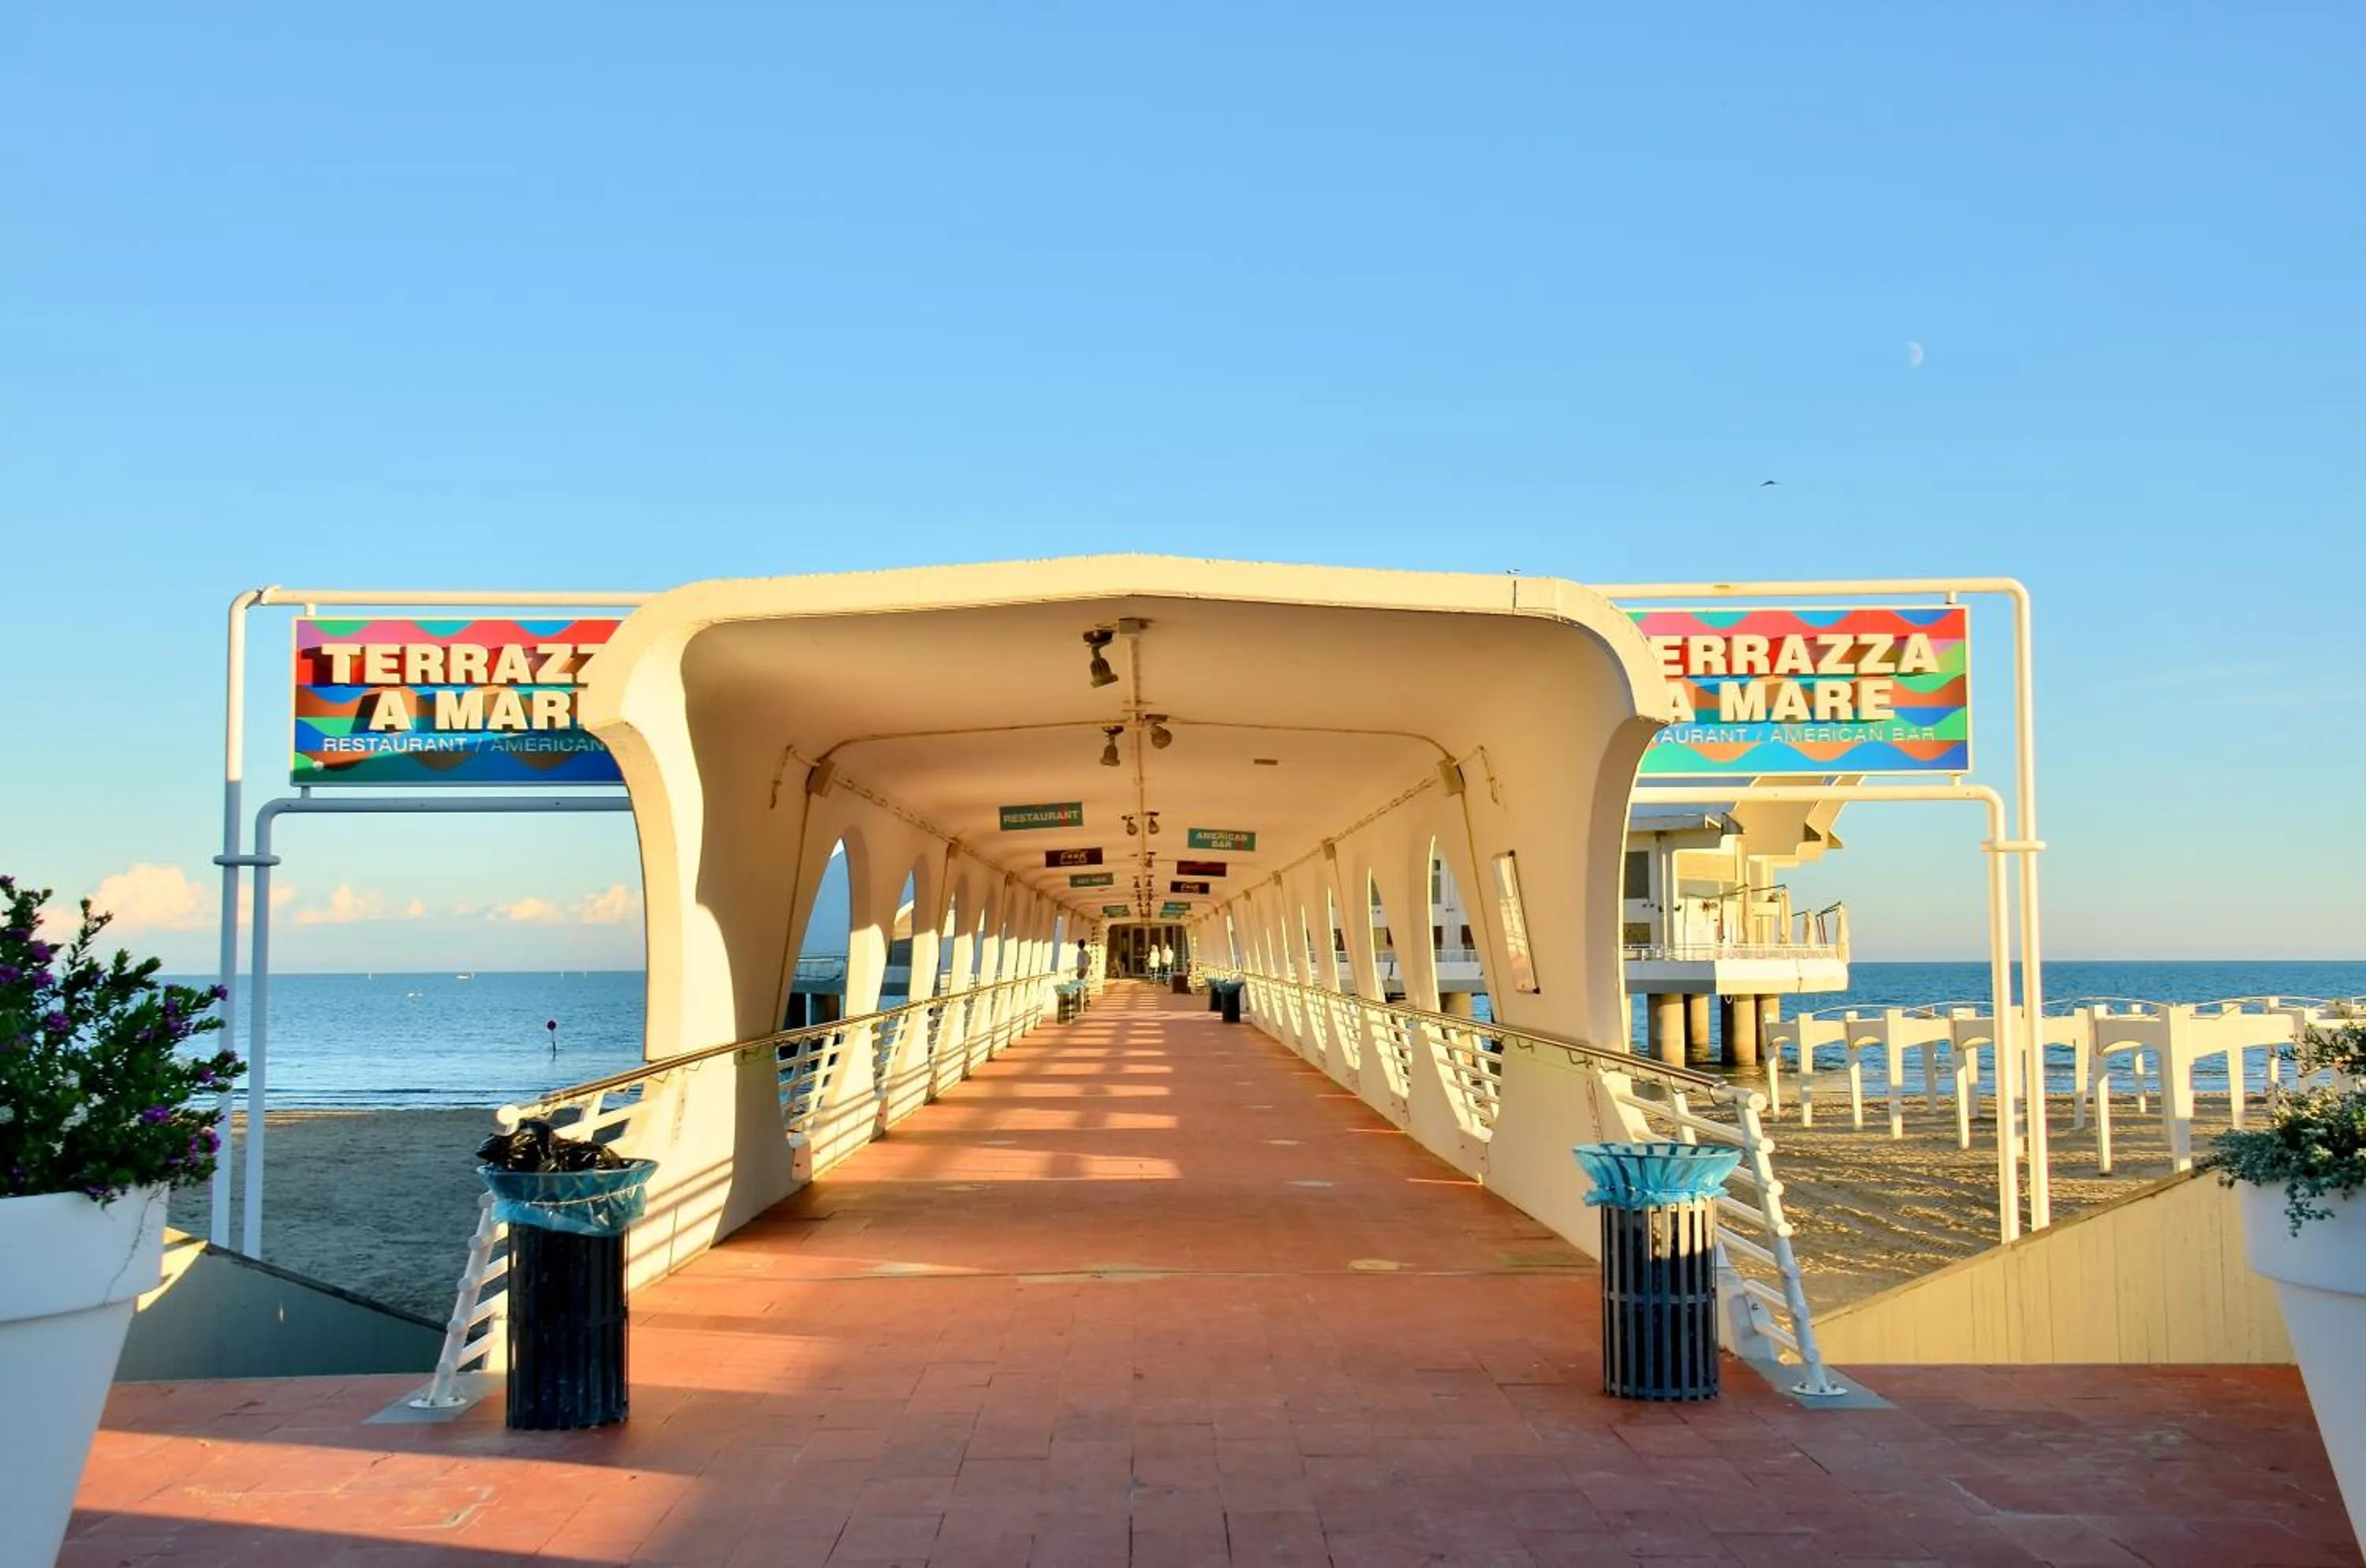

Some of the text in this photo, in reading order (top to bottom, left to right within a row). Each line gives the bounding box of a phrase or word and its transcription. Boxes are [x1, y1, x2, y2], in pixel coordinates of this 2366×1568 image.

[1665, 679, 1894, 722] A MARE
[368, 690, 586, 730] A MAR
[1770, 727, 1883, 743] AMERICAN
[1893, 727, 1935, 741] BAR
[323, 737, 467, 752] RESTAURANT
[490, 737, 606, 752] AMERICAN
[1003, 810, 1078, 823] RESTAURANT
[1196, 832, 1248, 842] AMERICAN
